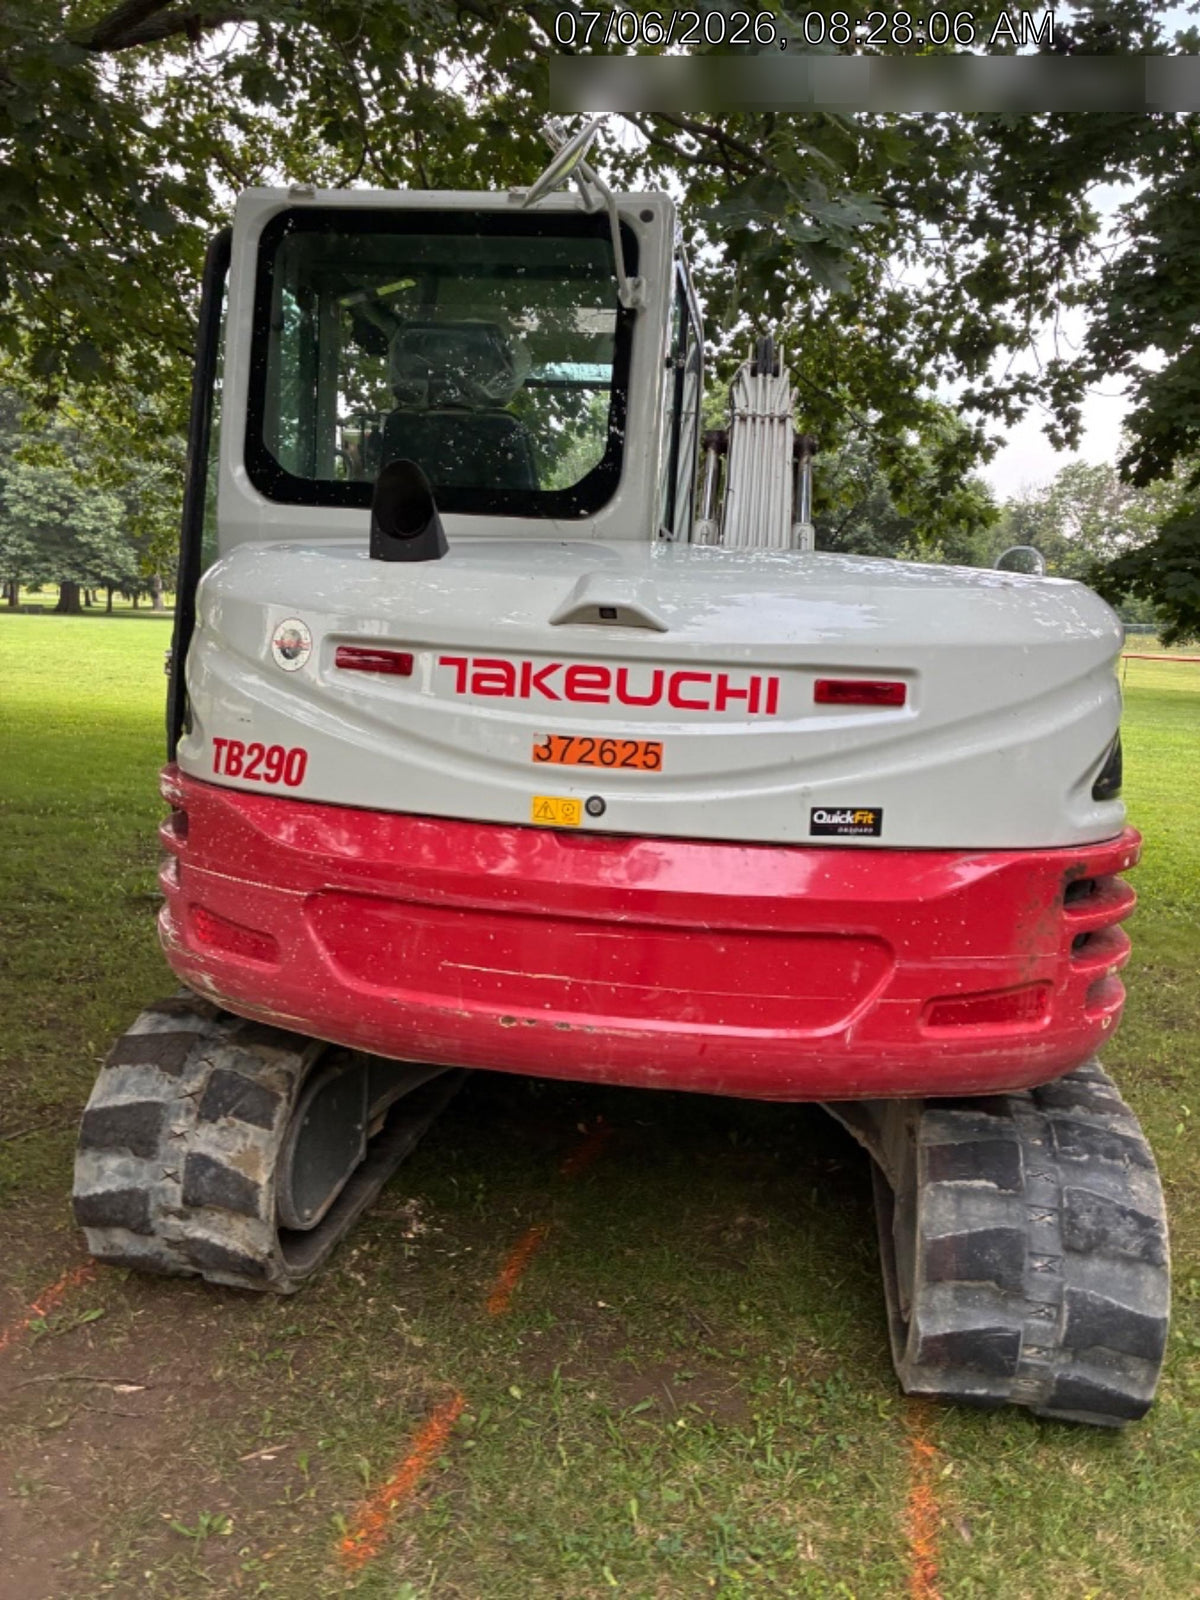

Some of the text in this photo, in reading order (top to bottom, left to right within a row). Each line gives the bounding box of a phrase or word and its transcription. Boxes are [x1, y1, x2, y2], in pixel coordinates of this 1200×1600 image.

[212, 737, 308, 787] TB290
[535, 734, 661, 769] 372625
[813, 810, 875, 824] QuickFit
